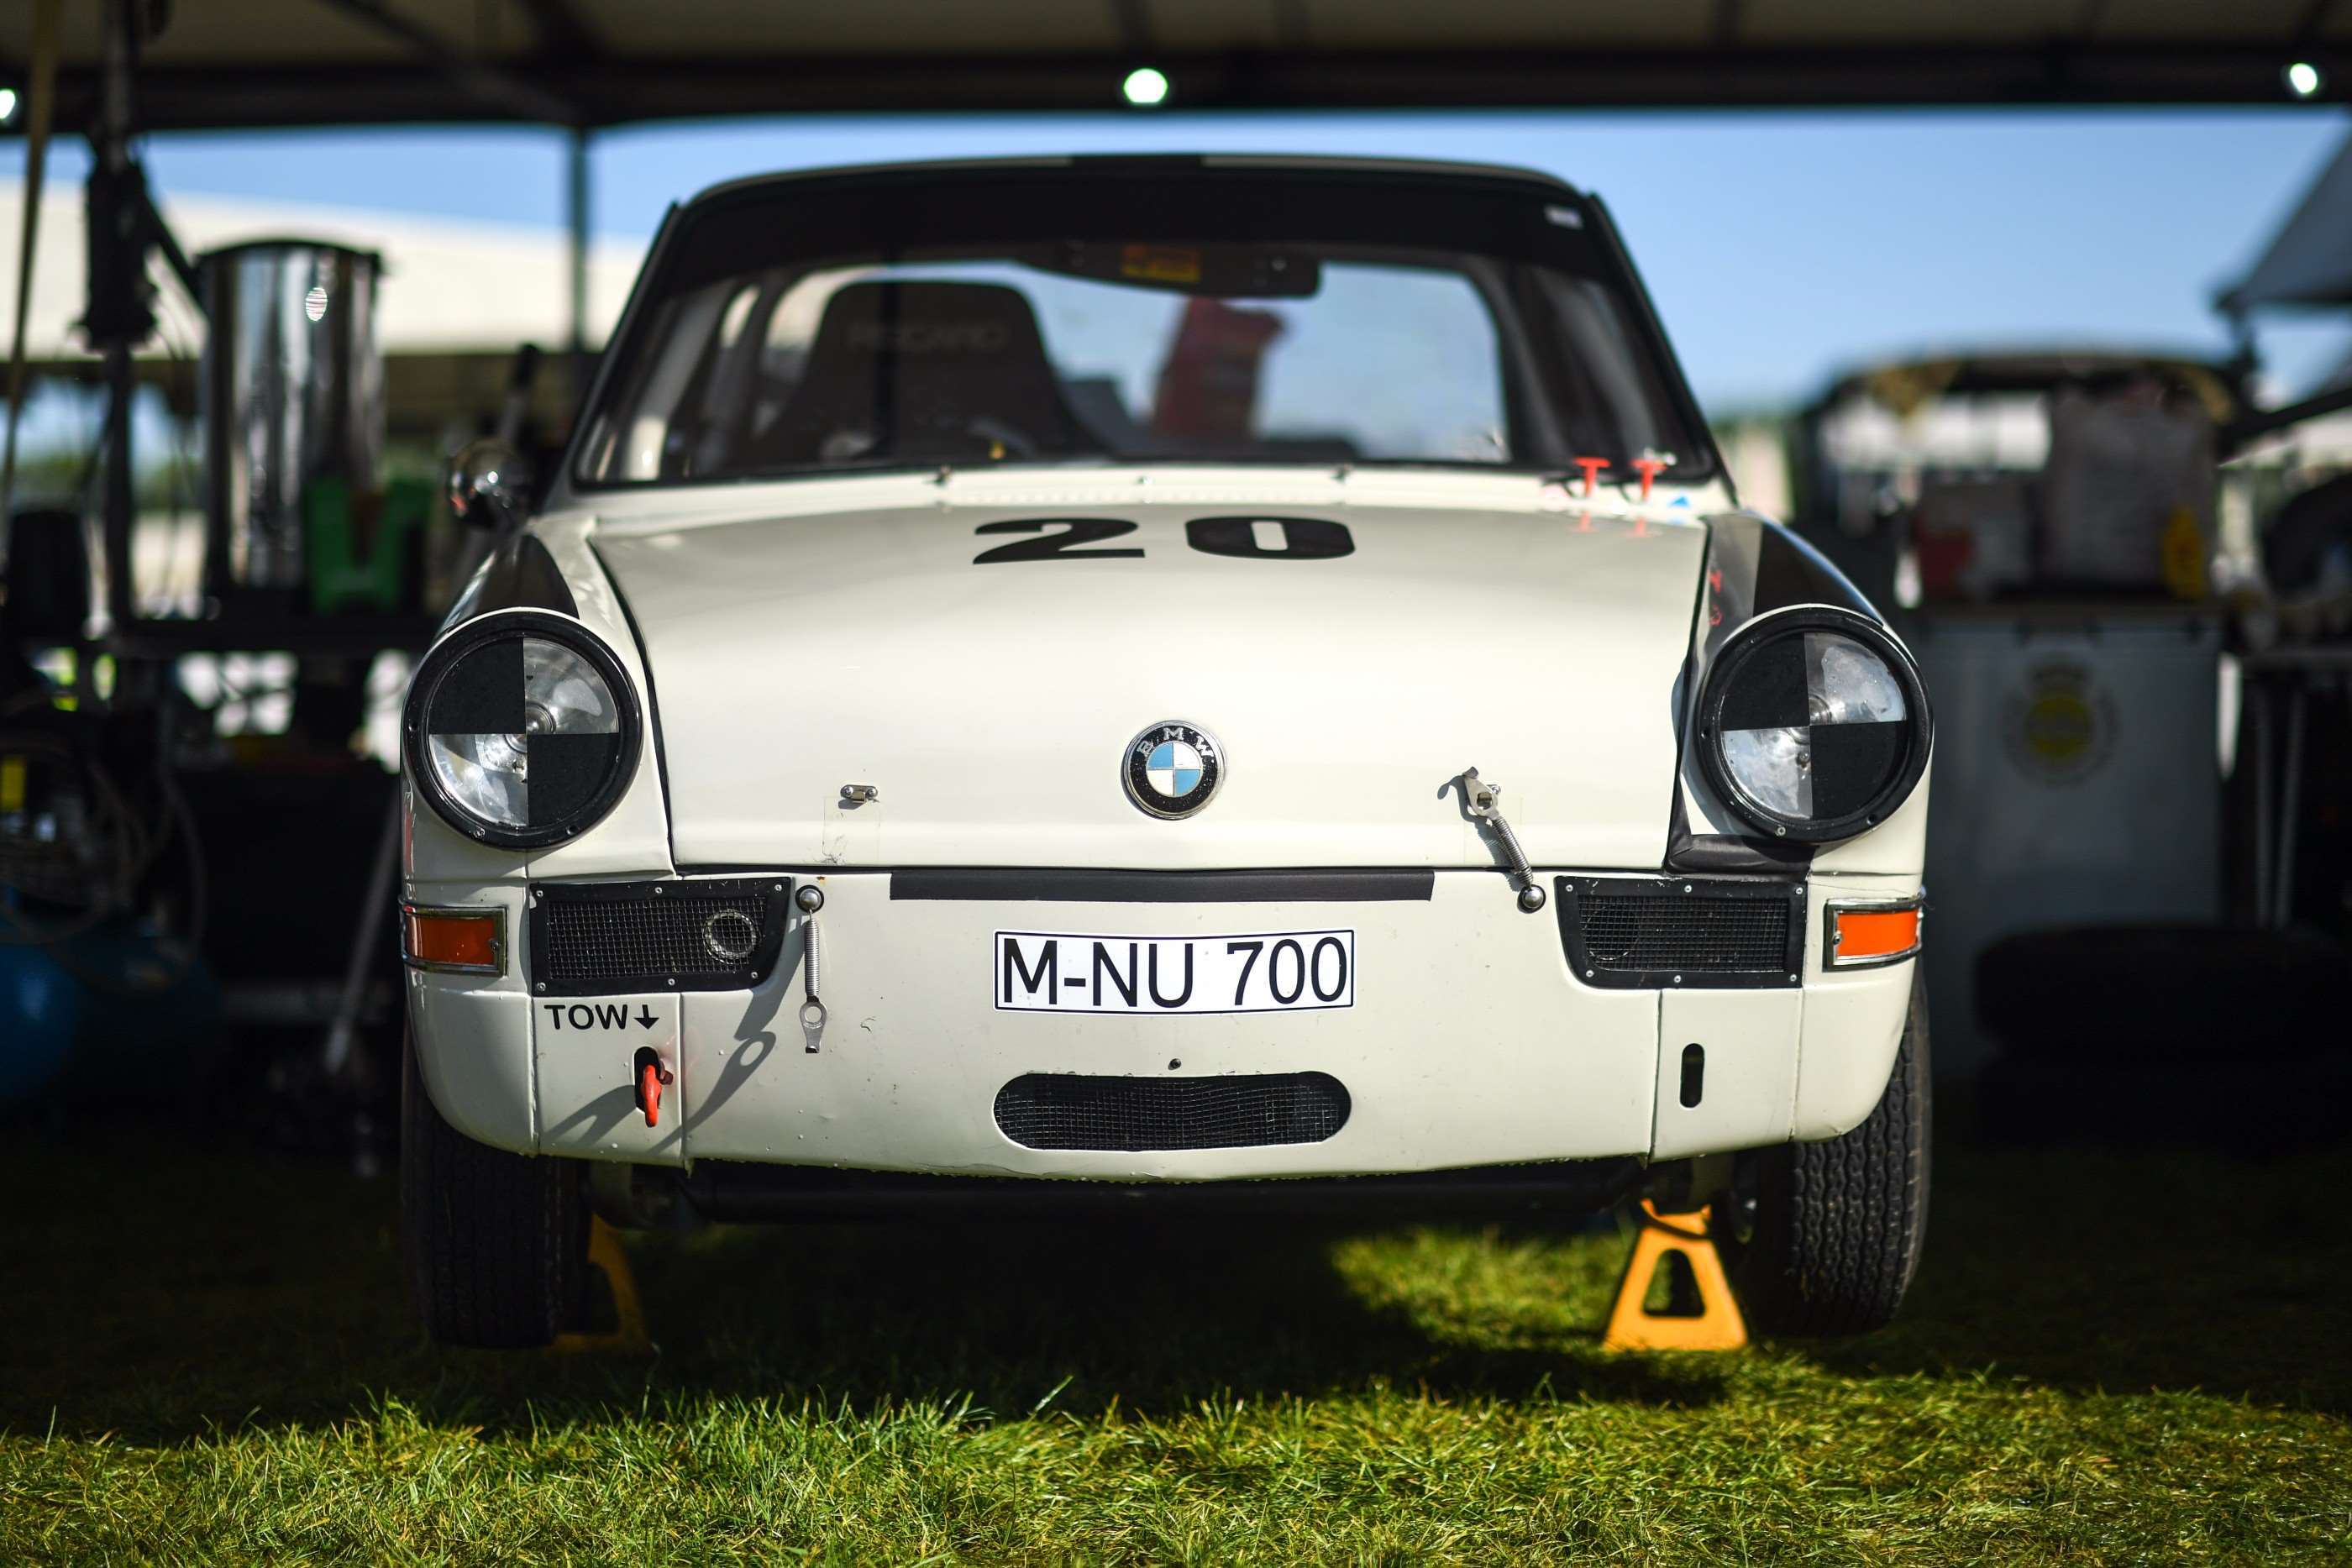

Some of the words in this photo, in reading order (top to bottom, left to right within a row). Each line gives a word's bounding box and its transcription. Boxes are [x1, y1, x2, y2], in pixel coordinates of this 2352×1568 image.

[974, 516, 1355, 565] 20
[1137, 727, 1214, 757] BMW
[1004, 938, 1194, 1009] M-NU
[1226, 936, 1348, 1006] 700
[543, 1004, 628, 1030] TOW
